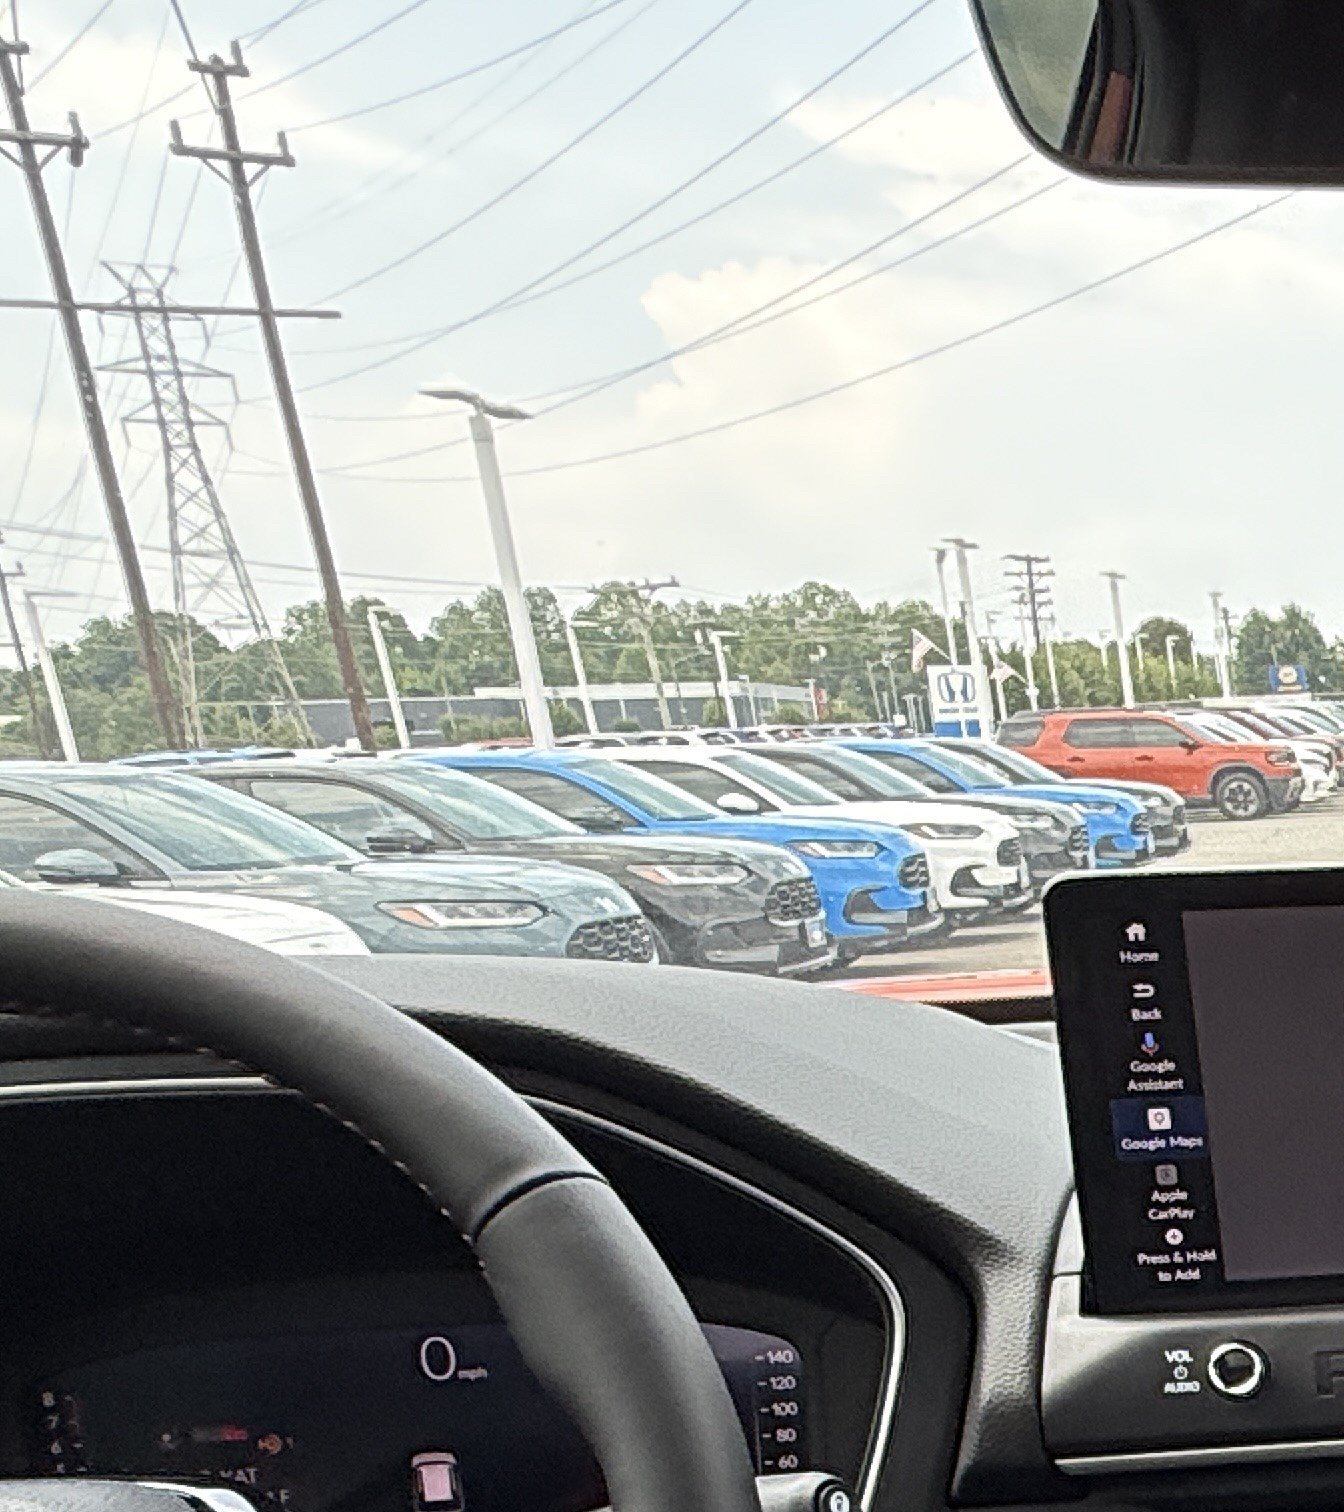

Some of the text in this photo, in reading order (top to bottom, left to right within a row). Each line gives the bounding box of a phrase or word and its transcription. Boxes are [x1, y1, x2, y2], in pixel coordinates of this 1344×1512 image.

[1119, 950, 1159, 963] Home
[1131, 1008, 1162, 1021] Back
[1130, 1059, 1176, 1073] Google
[1127, 1079, 1184, 1092] Assistant
[1121, 1136, 1203, 1151] Google Maps
[1151, 1189, 1188, 1203] Apple
[1148, 1208, 1195, 1220] CarPlay
[1137, 1249, 1218, 1265] Press & Hold
[1158, 1268, 1201, 1282] to Add
[420, 1335, 456, 1380] 0
[767, 1351, 793, 1364] 140
[1164, 1350, 1194, 1363] VOL
[770, 1375, 796, 1389] 120
[1164, 1381, 1200, 1394] AUDIO
[771, 1402, 798, 1415] 100
[776, 1428, 797, 1441] 80
[778, 1454, 798, 1468] 60
